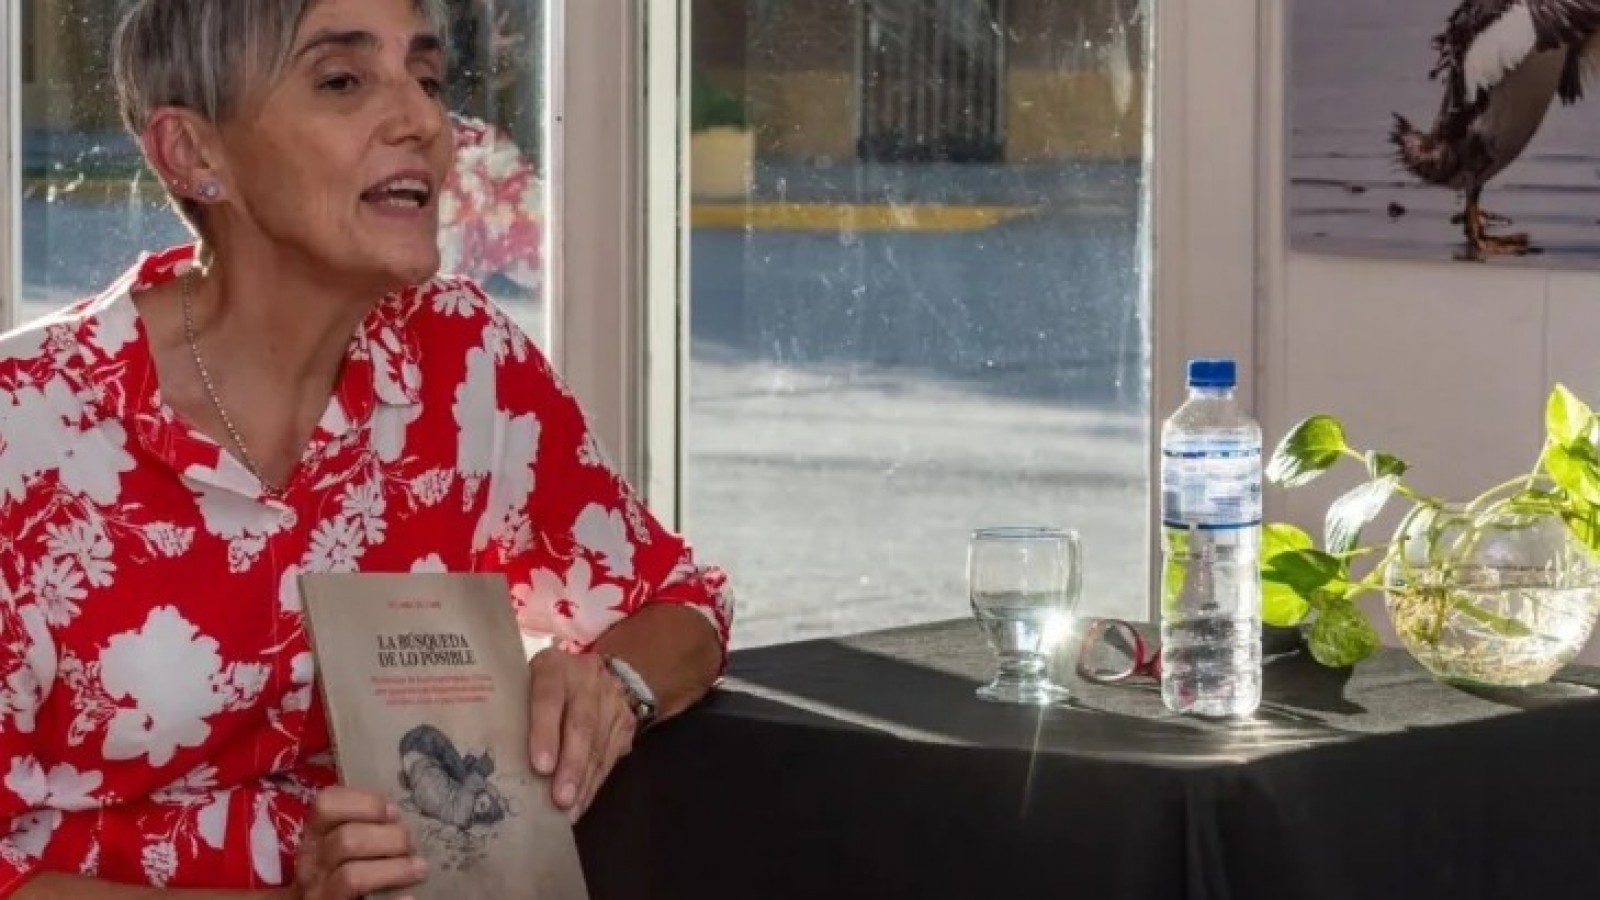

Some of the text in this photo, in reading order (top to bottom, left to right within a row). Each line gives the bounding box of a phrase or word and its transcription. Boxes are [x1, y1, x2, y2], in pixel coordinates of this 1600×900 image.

[377, 632, 469, 651] LA BÚSQUEDA
[378, 650, 476, 667] DE LO POSIBLE
